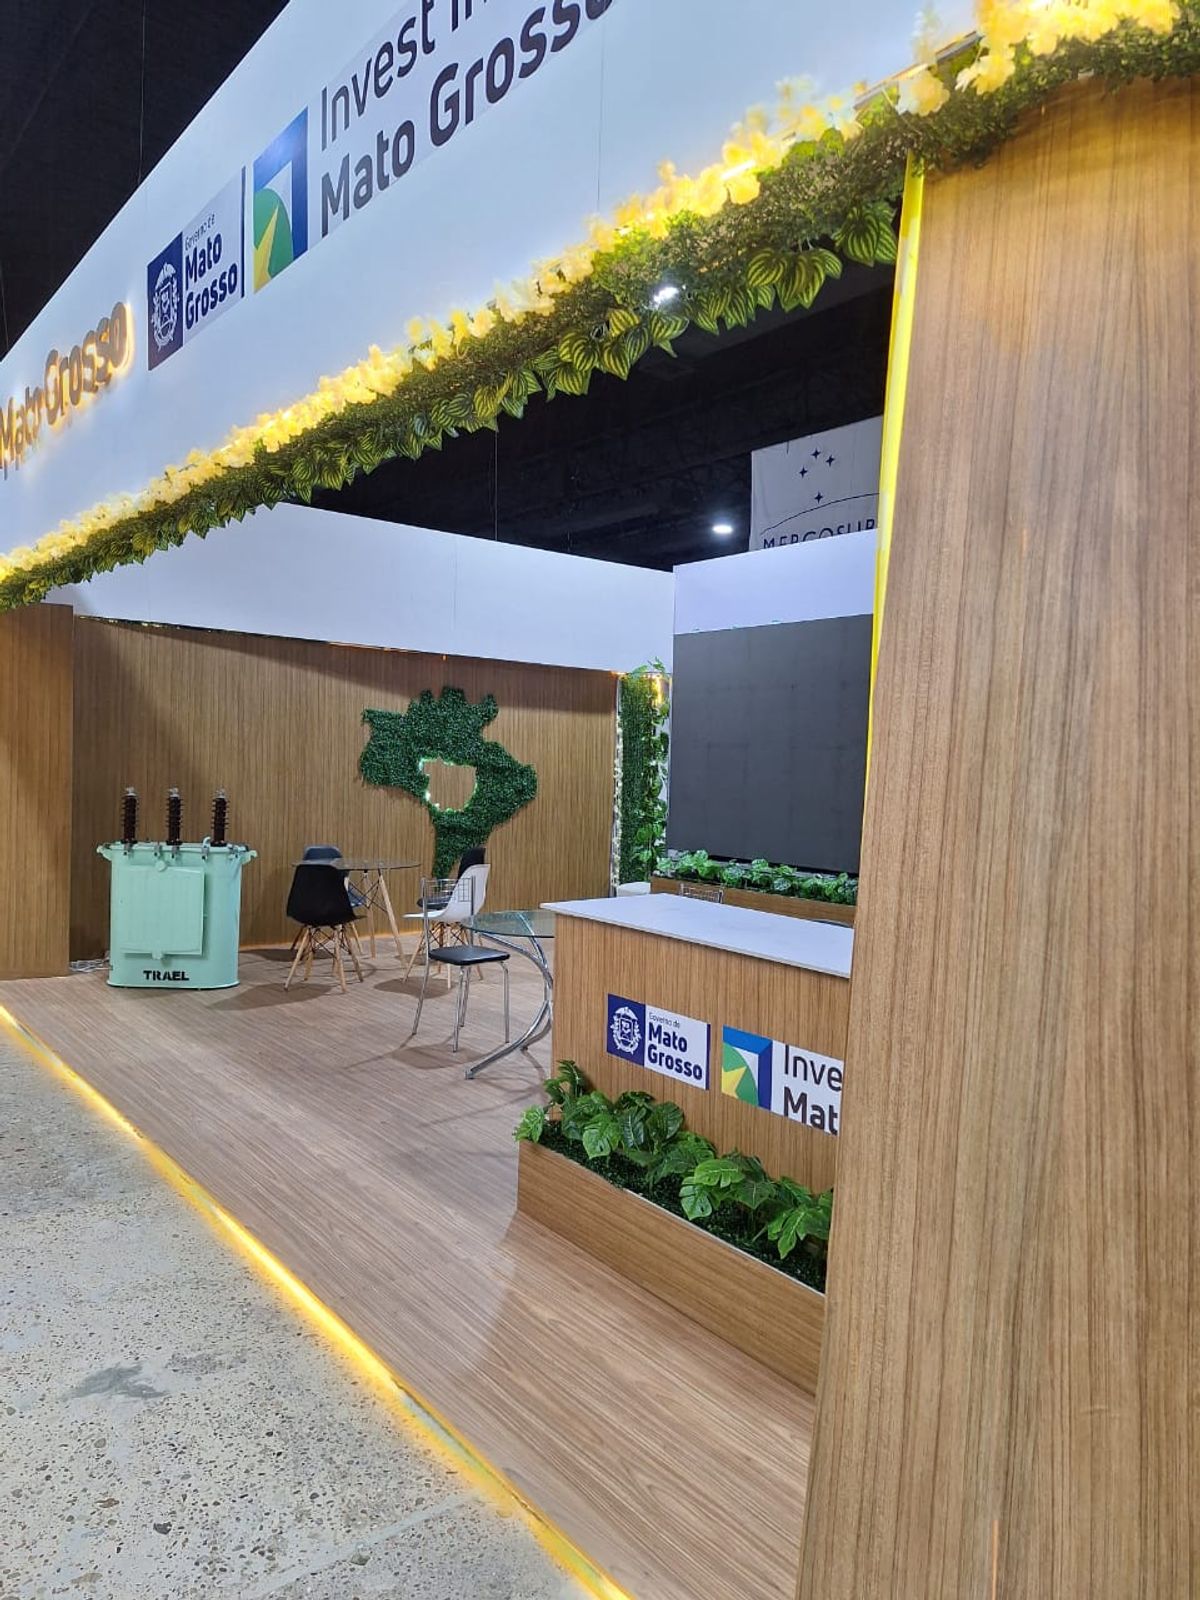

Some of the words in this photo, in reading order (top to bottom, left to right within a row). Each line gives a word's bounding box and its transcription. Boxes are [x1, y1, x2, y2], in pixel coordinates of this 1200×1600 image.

[321, 0, 436, 151] Invest
[321, 119, 415, 239] Mato
[429, 0, 613, 147] Gross
[185, 233, 222, 290] Mato
[185, 262, 238, 330] Grosso
[143, 970, 190, 981] TRAEL
[648, 1044, 703, 1080] Grosso
[649, 1022, 688, 1052] Mato
[785, 1045, 842, 1092] Inve
[784, 1086, 838, 1136] Mat
